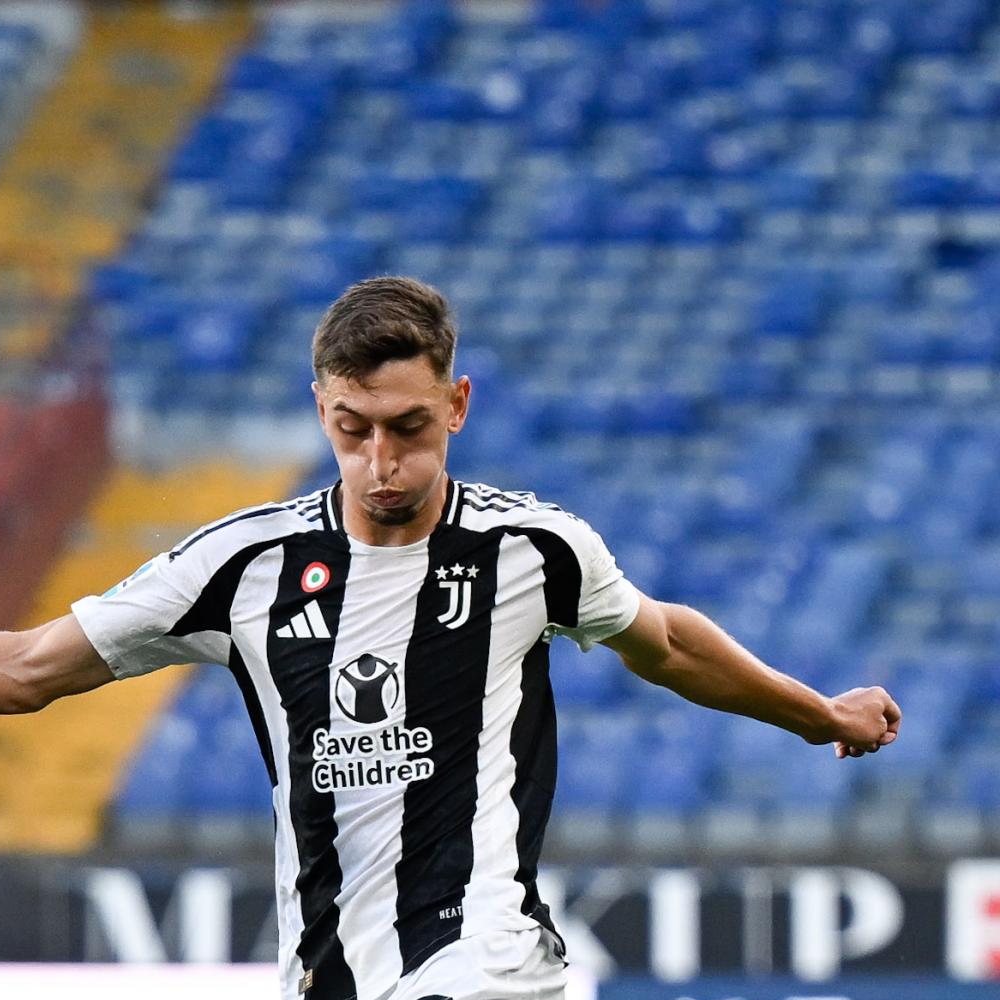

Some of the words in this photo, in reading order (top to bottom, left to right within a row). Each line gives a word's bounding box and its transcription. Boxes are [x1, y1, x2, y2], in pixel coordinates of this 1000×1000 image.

[314, 730, 374, 757] Save
[380, 726, 429, 752] the
[314, 759, 431, 790] Children
[438, 905, 463, 920] HEAT
